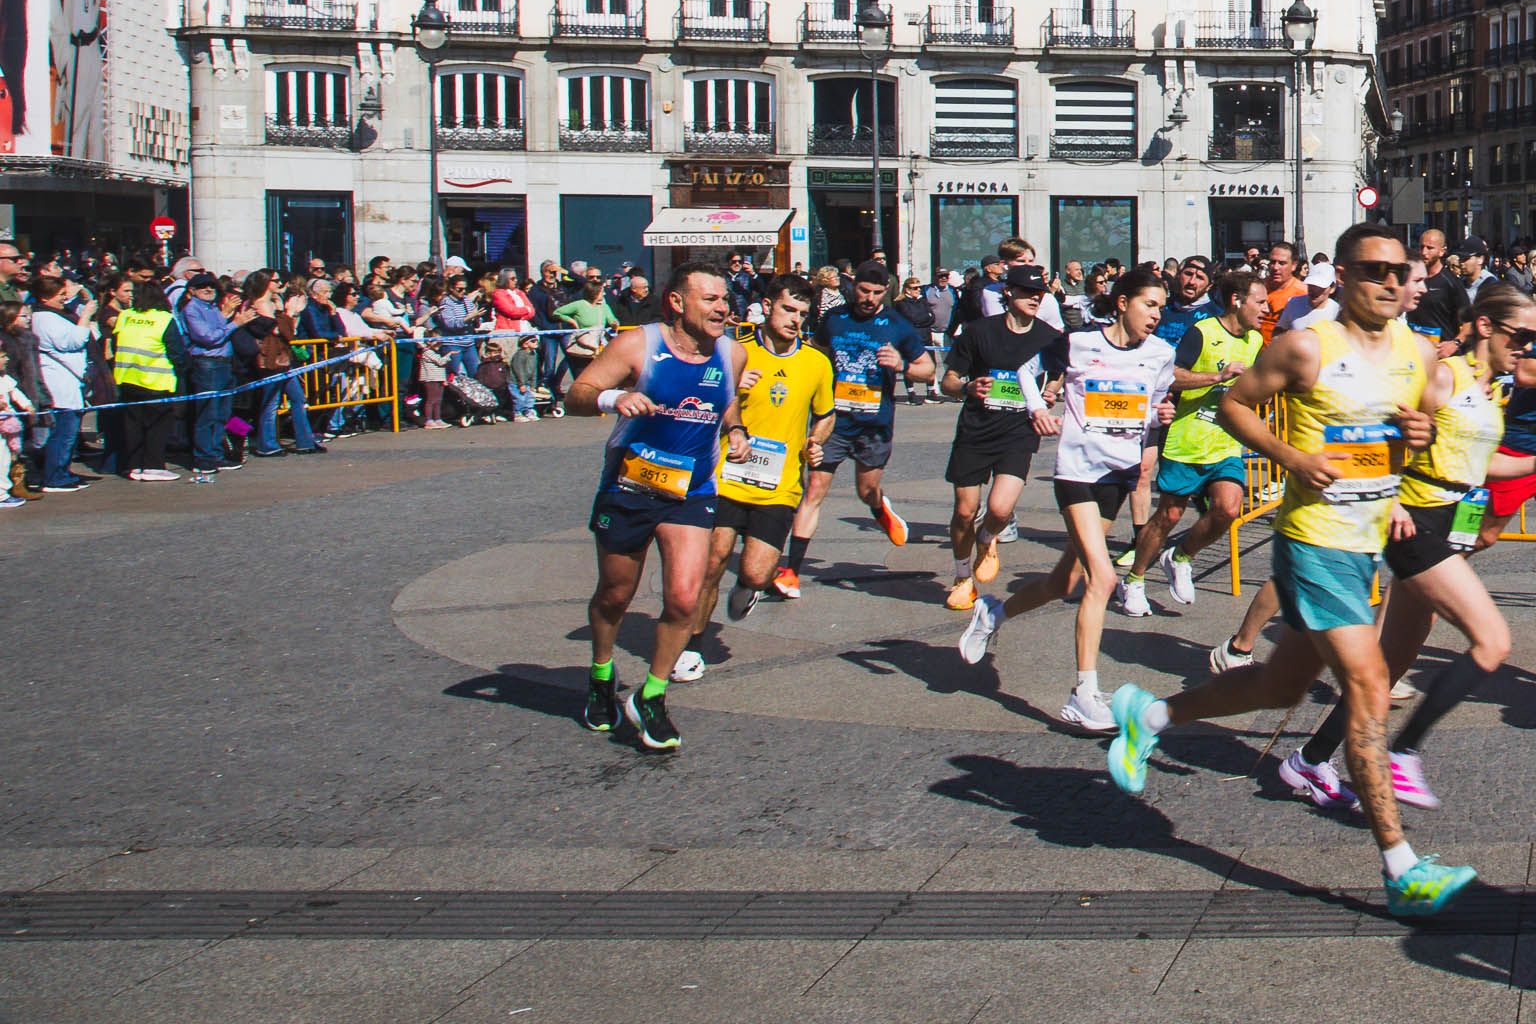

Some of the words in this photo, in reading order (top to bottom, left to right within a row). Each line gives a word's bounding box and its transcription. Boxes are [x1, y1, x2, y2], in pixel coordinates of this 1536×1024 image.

[441, 167, 512, 179] PRIMOR
[937, 181, 1009, 193] SEPHORA
[1209, 184, 1280, 195] SEPHORA
[650, 235, 706, 244] HELADOS
[711, 234, 772, 244] ITALIANOS
[1001, 385, 1021, 395] 8425
[1103, 399, 1129, 410] 2992
[641, 467, 668, 483] 3513
